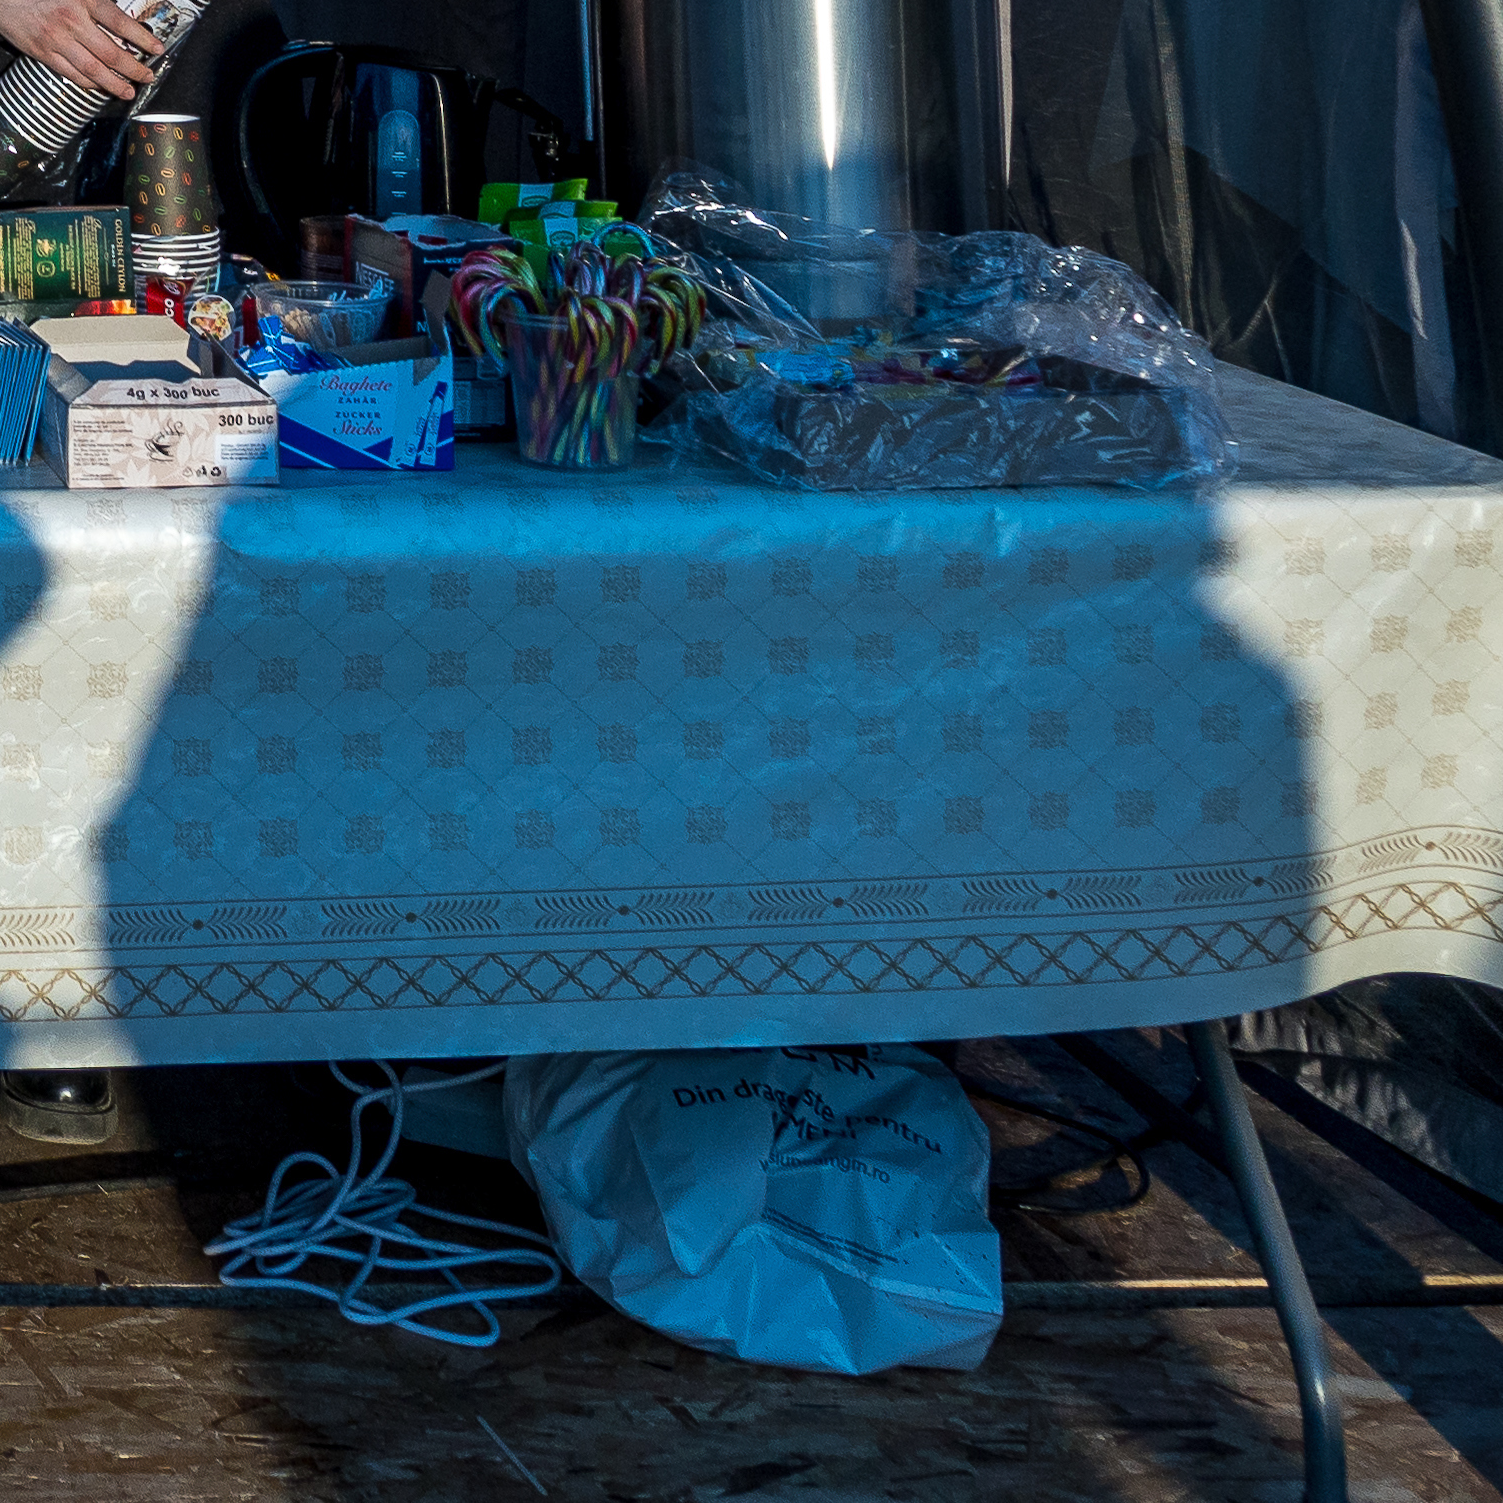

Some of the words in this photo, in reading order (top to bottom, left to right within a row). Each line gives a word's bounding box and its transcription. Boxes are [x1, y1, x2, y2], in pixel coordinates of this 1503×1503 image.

[320, 374, 393, 395] Baghete
[126, 387, 145, 400] 4g
[150, 389, 159, 398] x
[164, 387, 188, 399] 300
[191, 386, 220, 398] buc
[218, 414, 243, 427] 300
[247, 413, 275, 427] buc
[335, 411, 381, 419] ZUCKER
[332, 420, 383, 436] Sticks
[673, 1085, 727, 1108] Din
[847, 1113, 942, 1154] pentru
